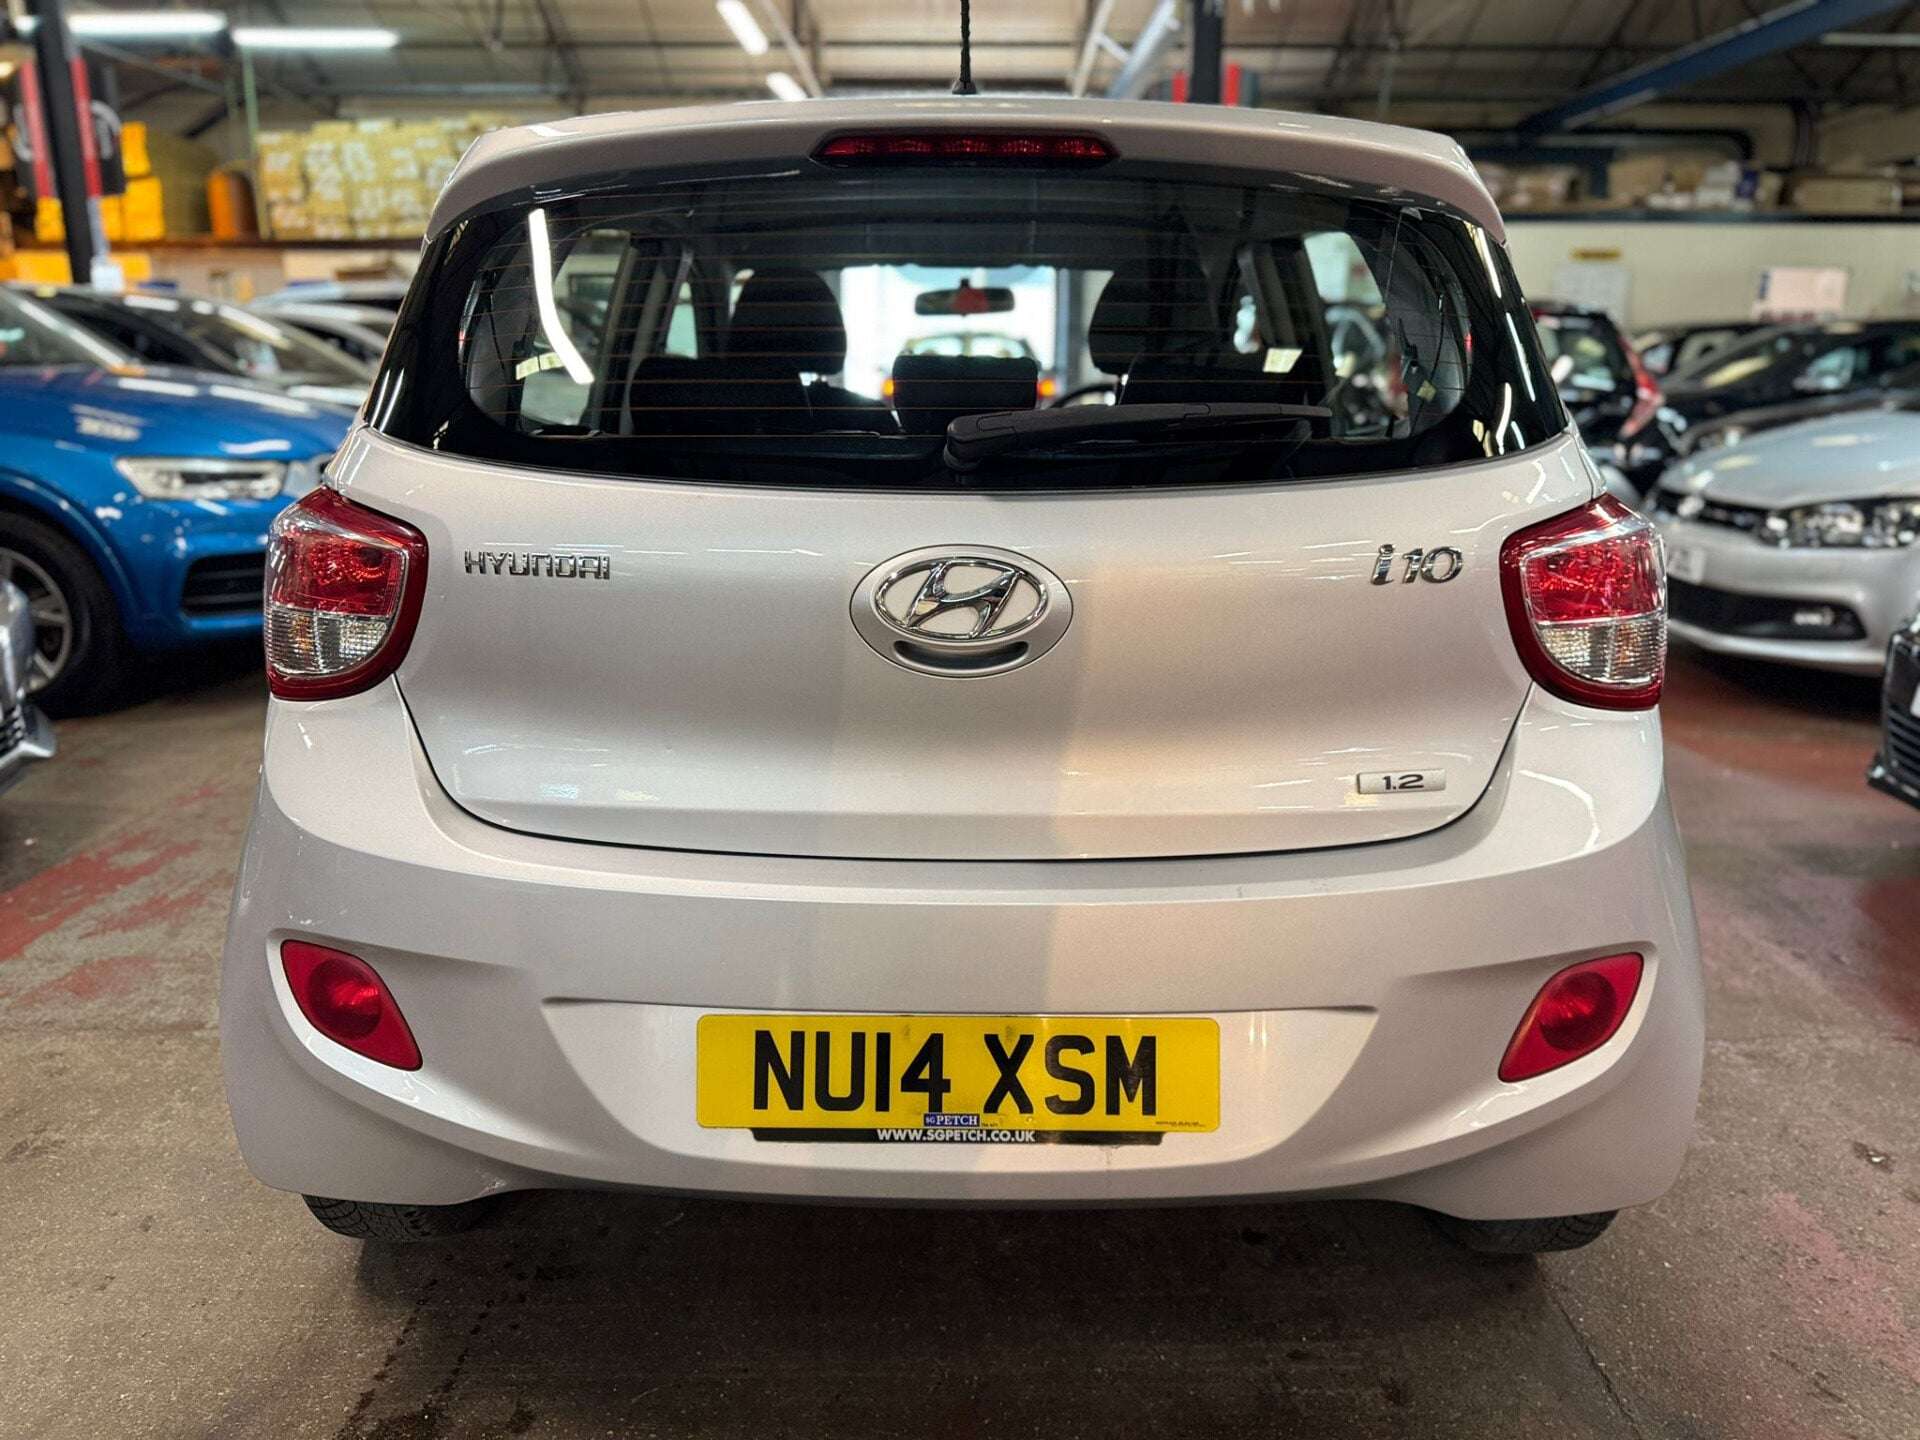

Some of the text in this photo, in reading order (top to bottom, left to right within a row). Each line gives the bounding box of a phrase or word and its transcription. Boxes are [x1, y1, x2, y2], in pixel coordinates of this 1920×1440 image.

[464, 550, 610, 580] HYUNDAI
[1382, 774, 1424, 790] 1.2
[753, 1030, 1157, 1116] NU14 XSM
[936, 1115, 978, 1126] PETCH
[877, 1129, 1036, 1143] WWW.SGPETCH.CO.UK
